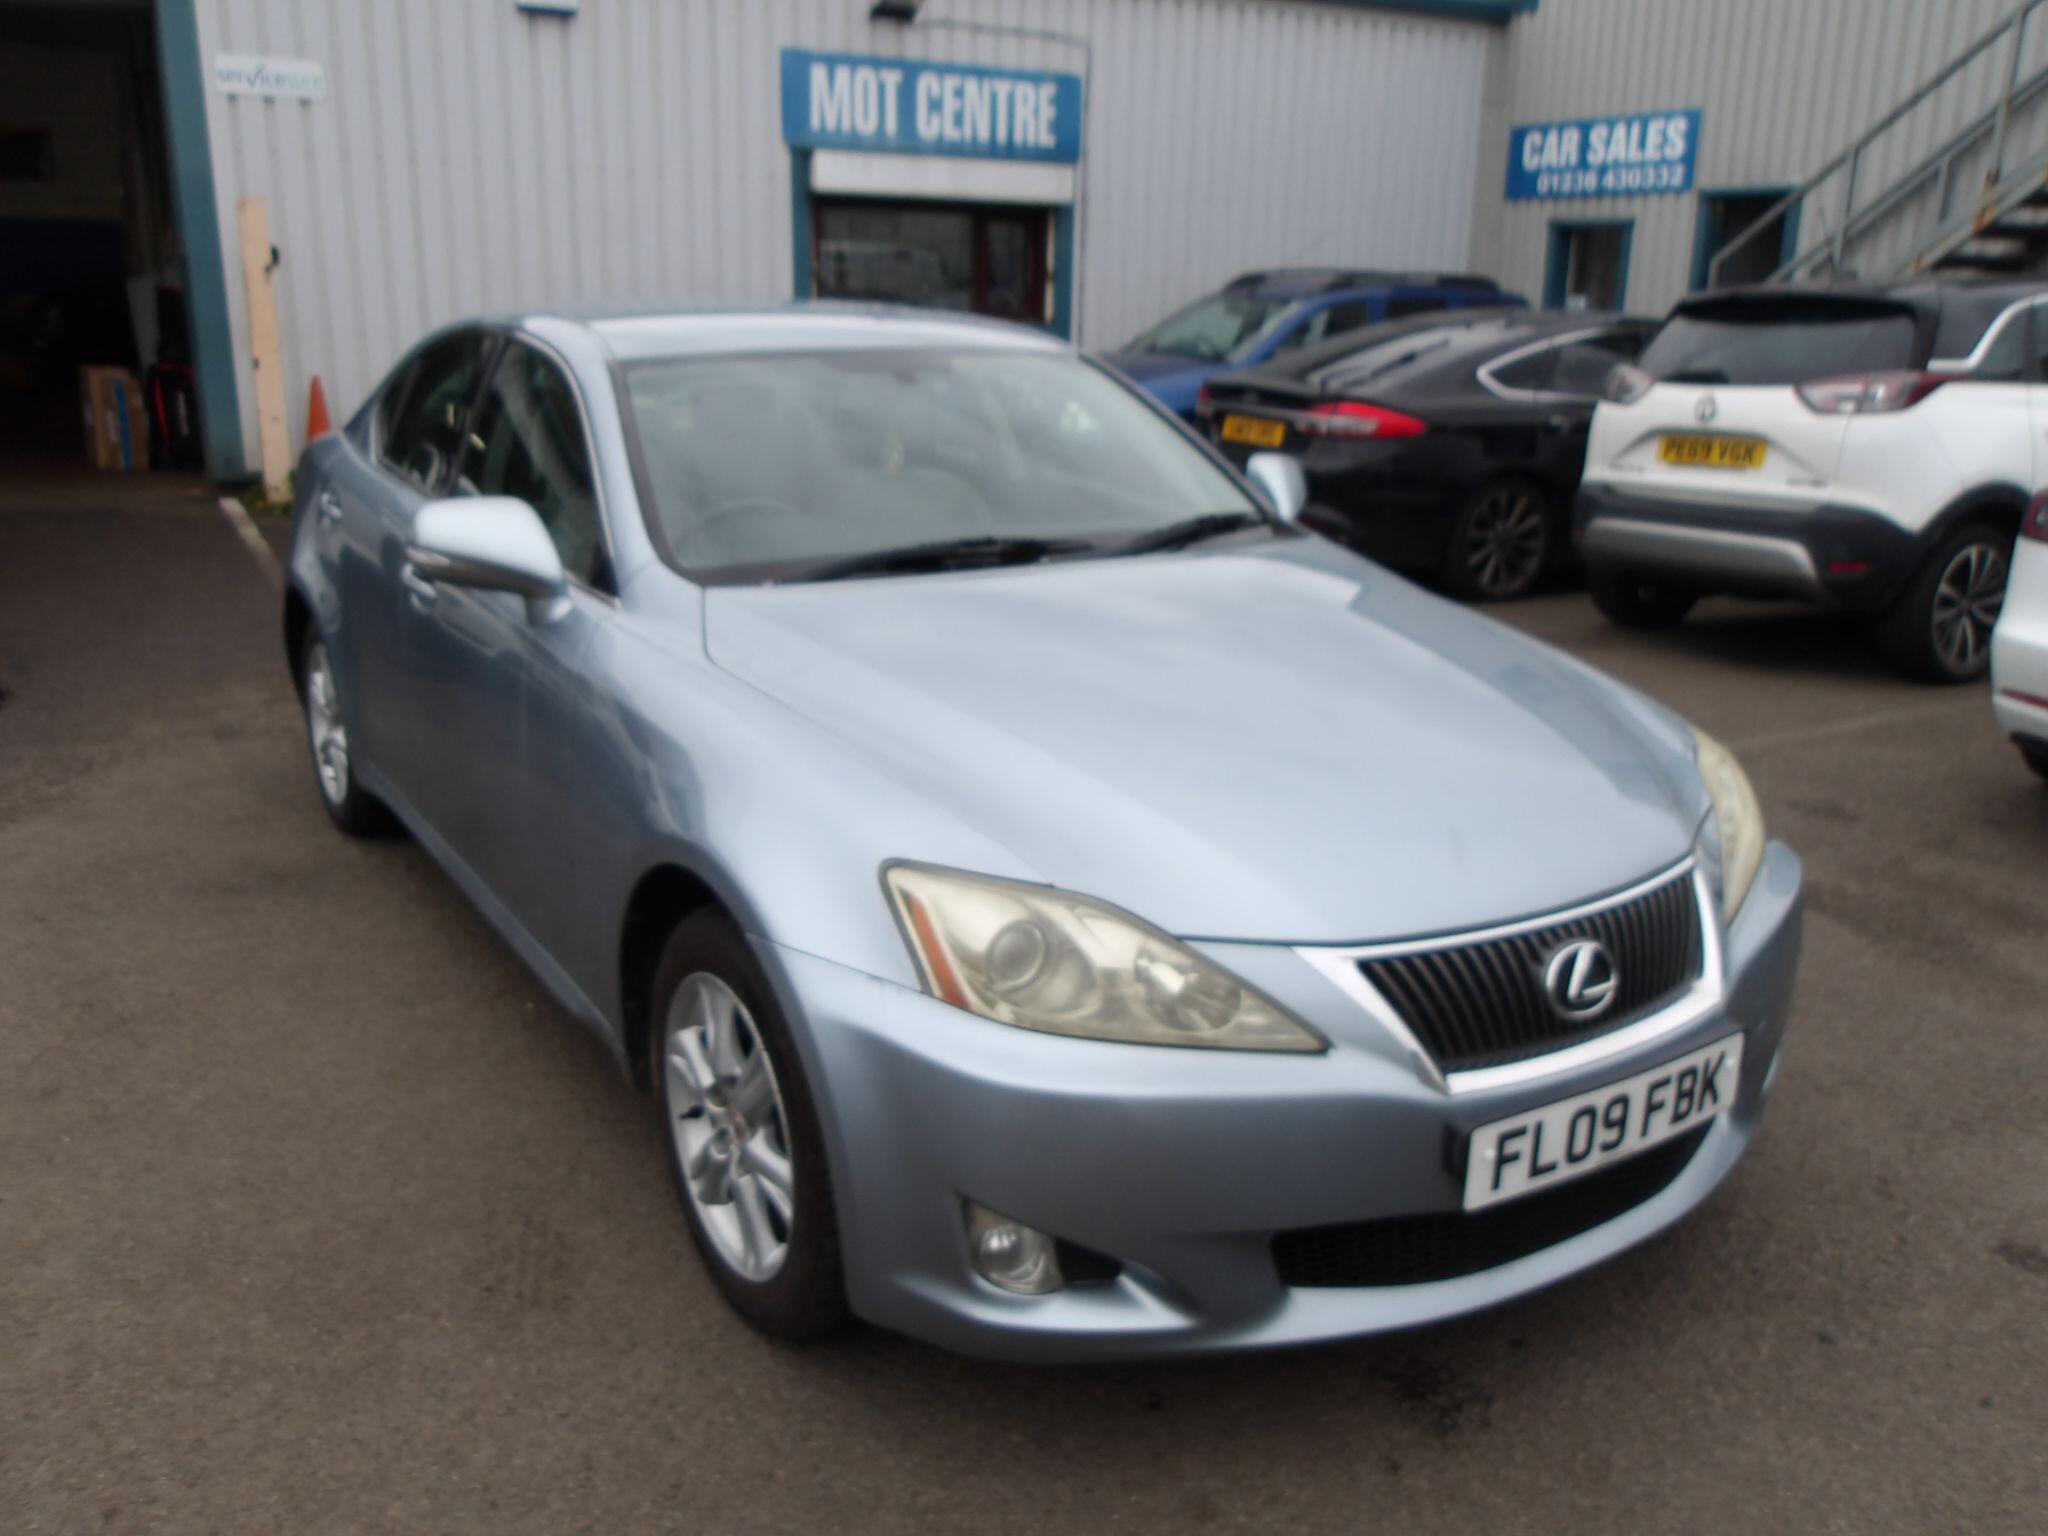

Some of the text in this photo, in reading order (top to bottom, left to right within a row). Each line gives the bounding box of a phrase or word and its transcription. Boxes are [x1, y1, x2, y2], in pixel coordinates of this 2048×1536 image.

[809, 62, 1058, 149] MOT CENTRE
[1522, 115, 1688, 173] CAR SALES
[1491, 1050, 1726, 1191] FL09 FBK
